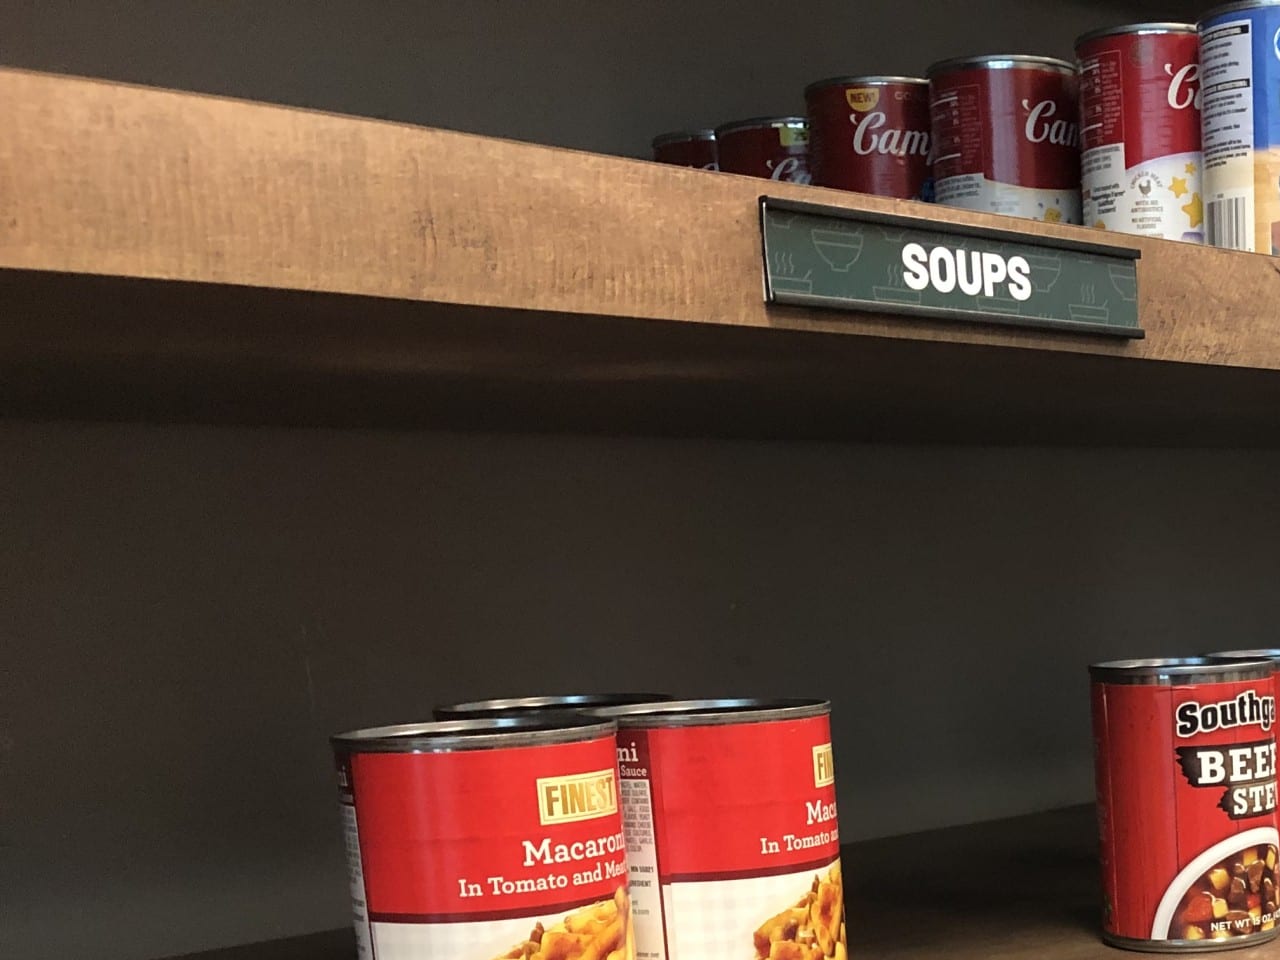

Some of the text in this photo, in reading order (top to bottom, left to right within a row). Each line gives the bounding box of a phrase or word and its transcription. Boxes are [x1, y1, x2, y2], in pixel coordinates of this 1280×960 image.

[901, 242, 1032, 301] SOUPS
[620, 766, 648, 777] Sauce
[544, 777, 614, 817] FINEST
[760, 828, 830, 855] In Tomato
[458, 863, 602, 897] In Tomato and
[1211, 918, 1250, 932] NET WT
